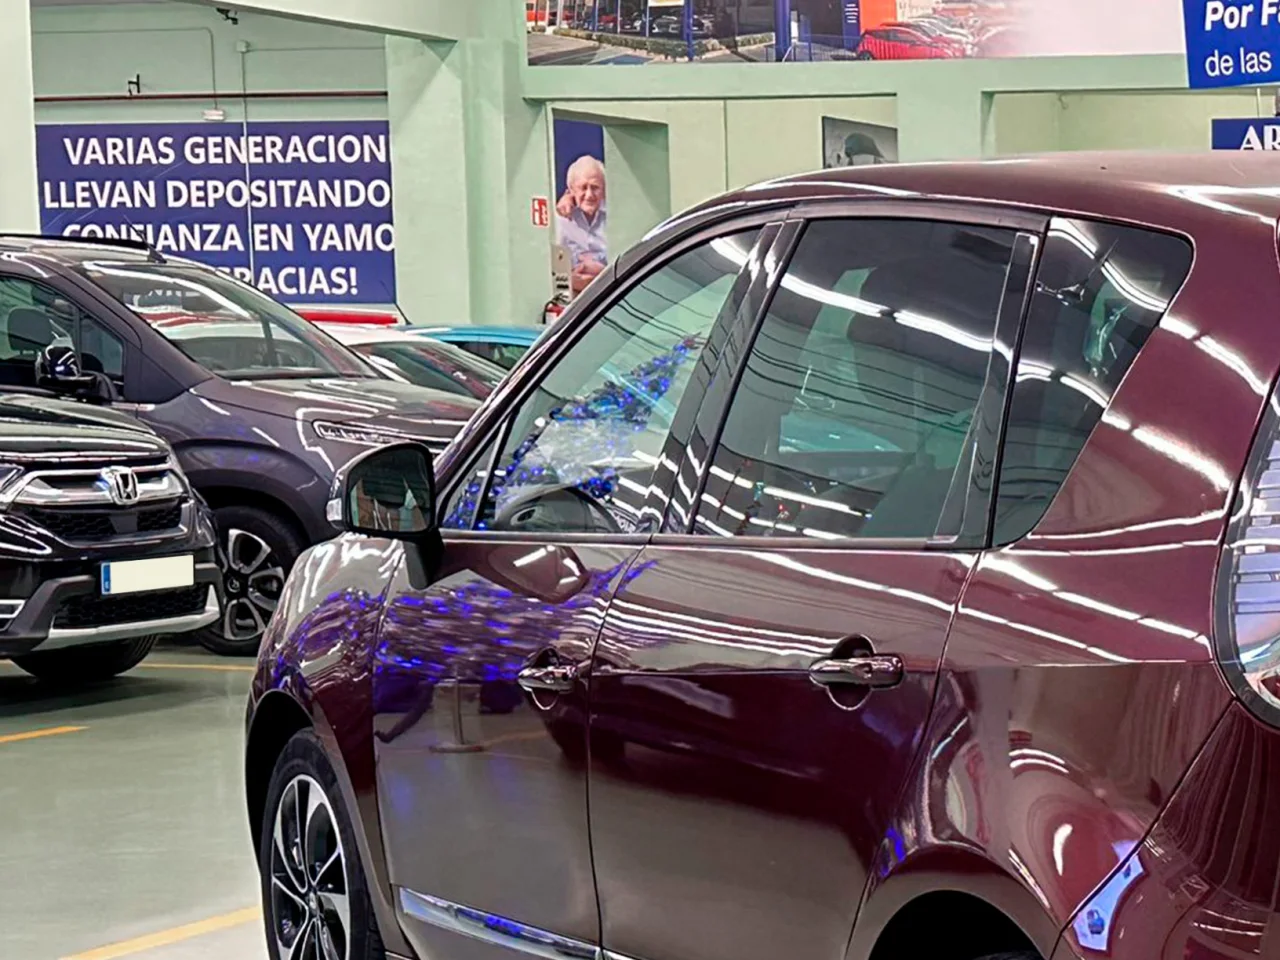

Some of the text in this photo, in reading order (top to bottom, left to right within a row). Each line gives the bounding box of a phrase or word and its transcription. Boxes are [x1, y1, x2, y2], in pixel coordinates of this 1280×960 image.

[1204, 0, 1253, 31] Por
[1205, 50, 1234, 77] de
[1240, 47, 1272, 74] las
[63, 134, 387, 165] VARIAS GENERACION
[43, 178, 391, 208] LLEVAN DEPOSITANDO
[253, 223, 294, 251] EN
[302, 222, 395, 251] YAMO
[217, 266, 358, 295] RACIAS!
